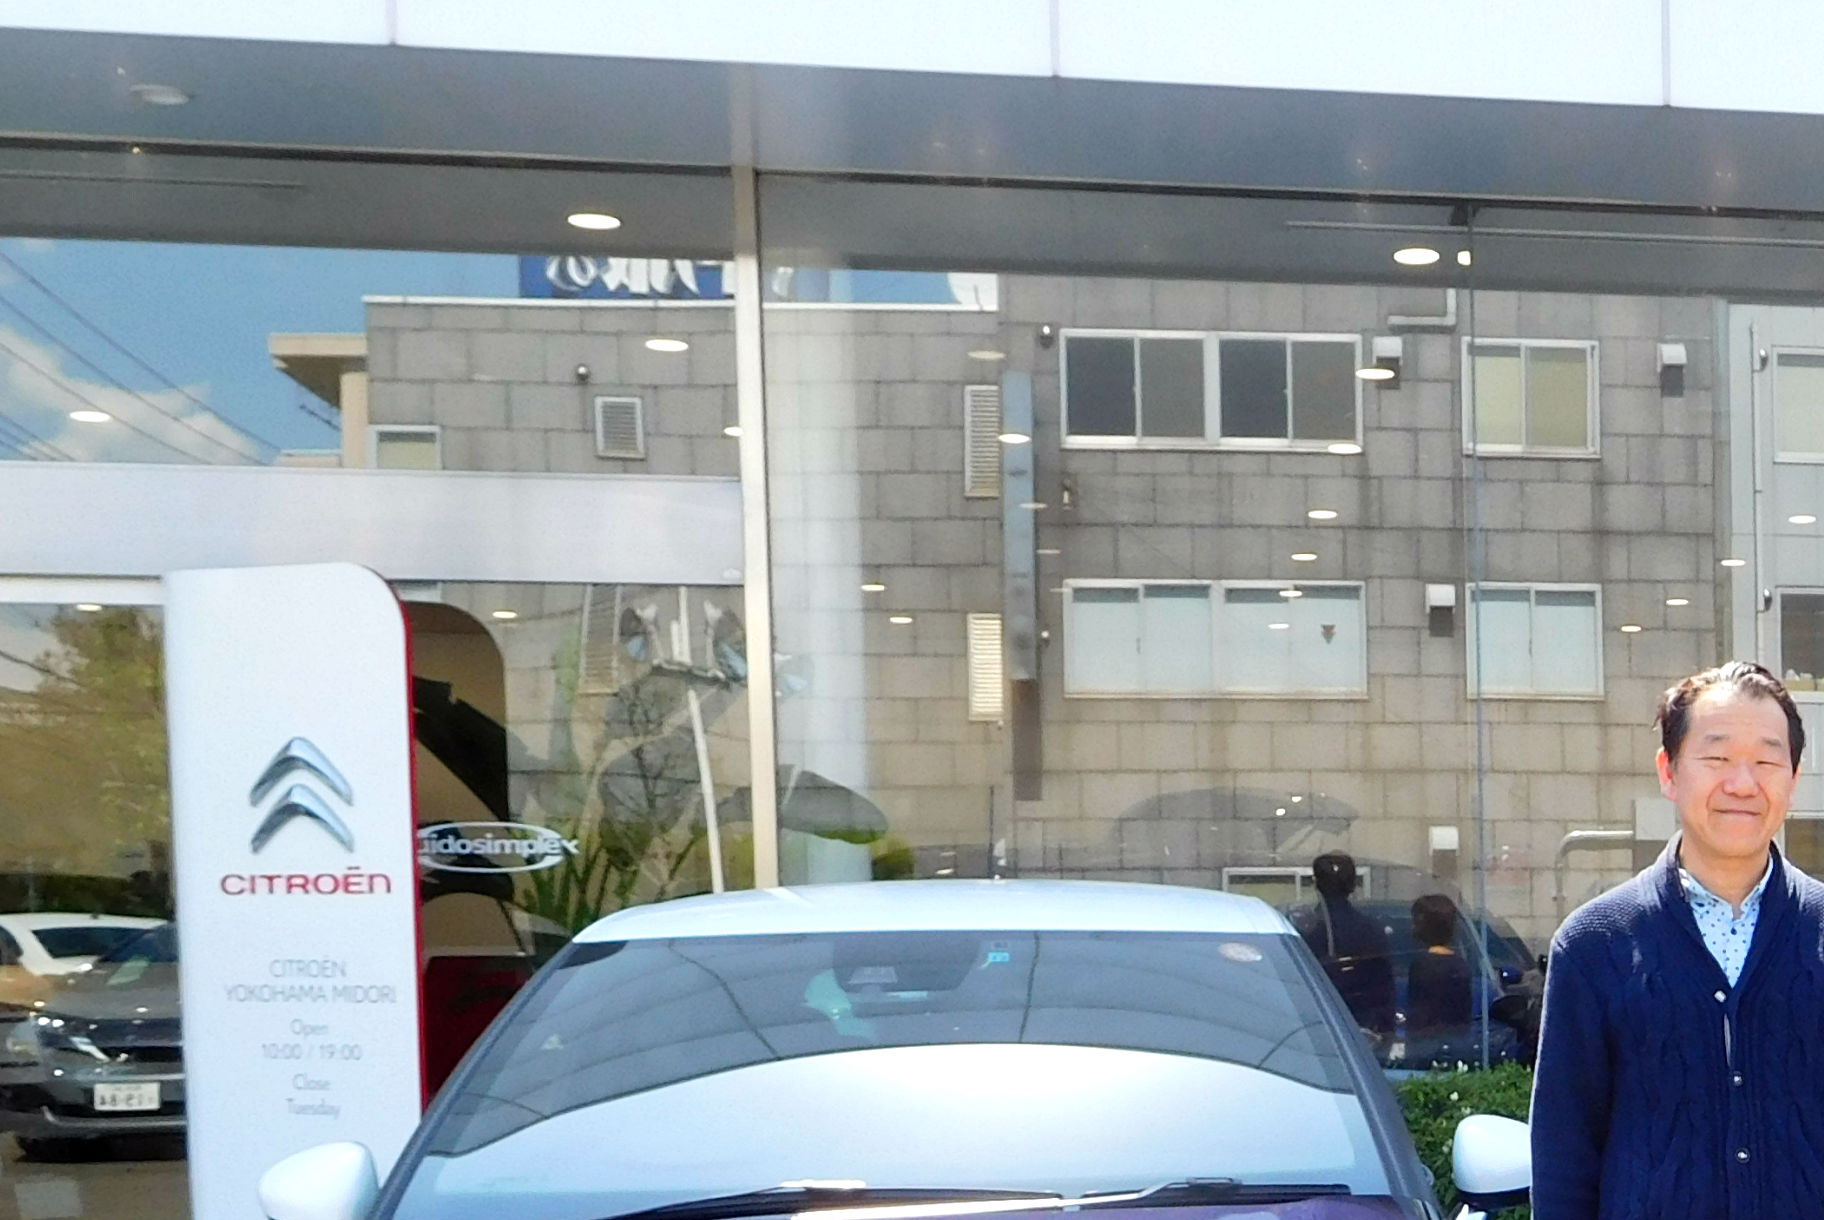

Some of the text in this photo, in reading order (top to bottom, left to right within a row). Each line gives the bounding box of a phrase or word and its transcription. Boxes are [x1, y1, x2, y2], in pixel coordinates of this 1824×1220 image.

[225, 984, 397, 1003] YOKOHAMA MIDORI
[289, 1018, 329, 1039] Open
[261, 1043, 303, 1060] 10:00
[292, 1073, 331, 1090] Close
[285, 1098, 341, 1120] Tuesday
